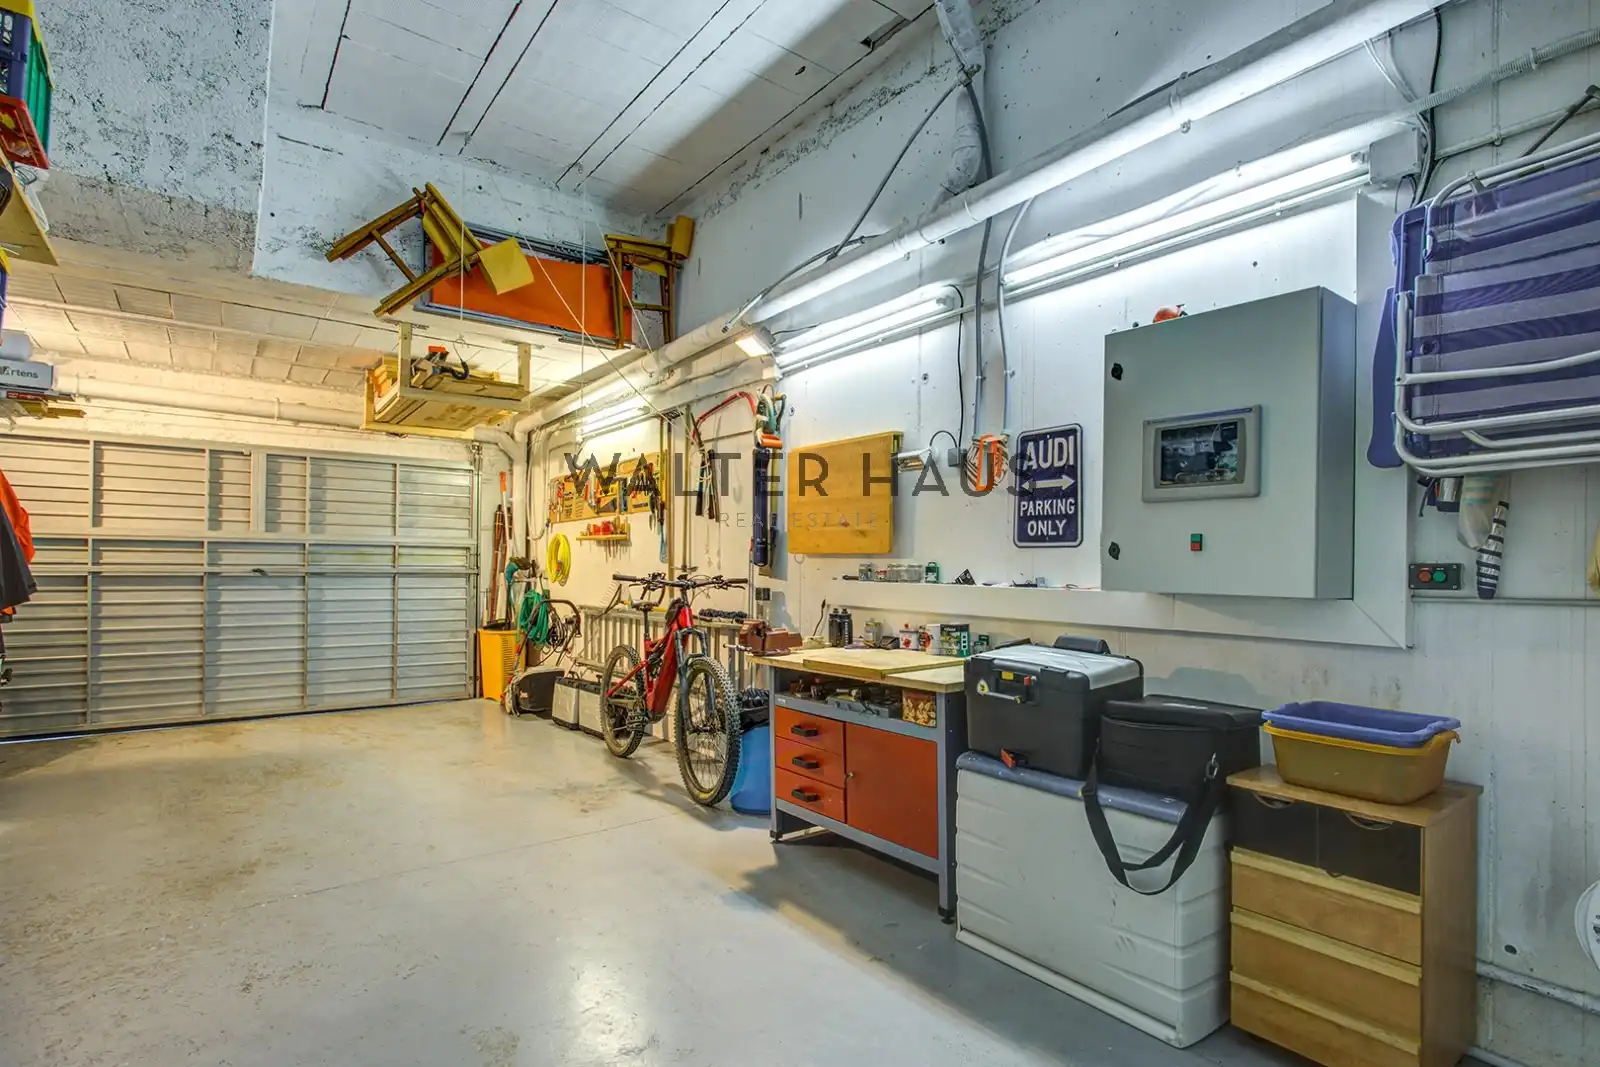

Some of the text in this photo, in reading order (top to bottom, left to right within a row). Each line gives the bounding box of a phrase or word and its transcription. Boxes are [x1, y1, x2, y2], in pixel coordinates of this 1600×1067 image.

[1022, 436, 1075, 471] AUDI
[1020, 498, 1075, 517] PARKING
[1027, 519, 1067, 536] ONLY
